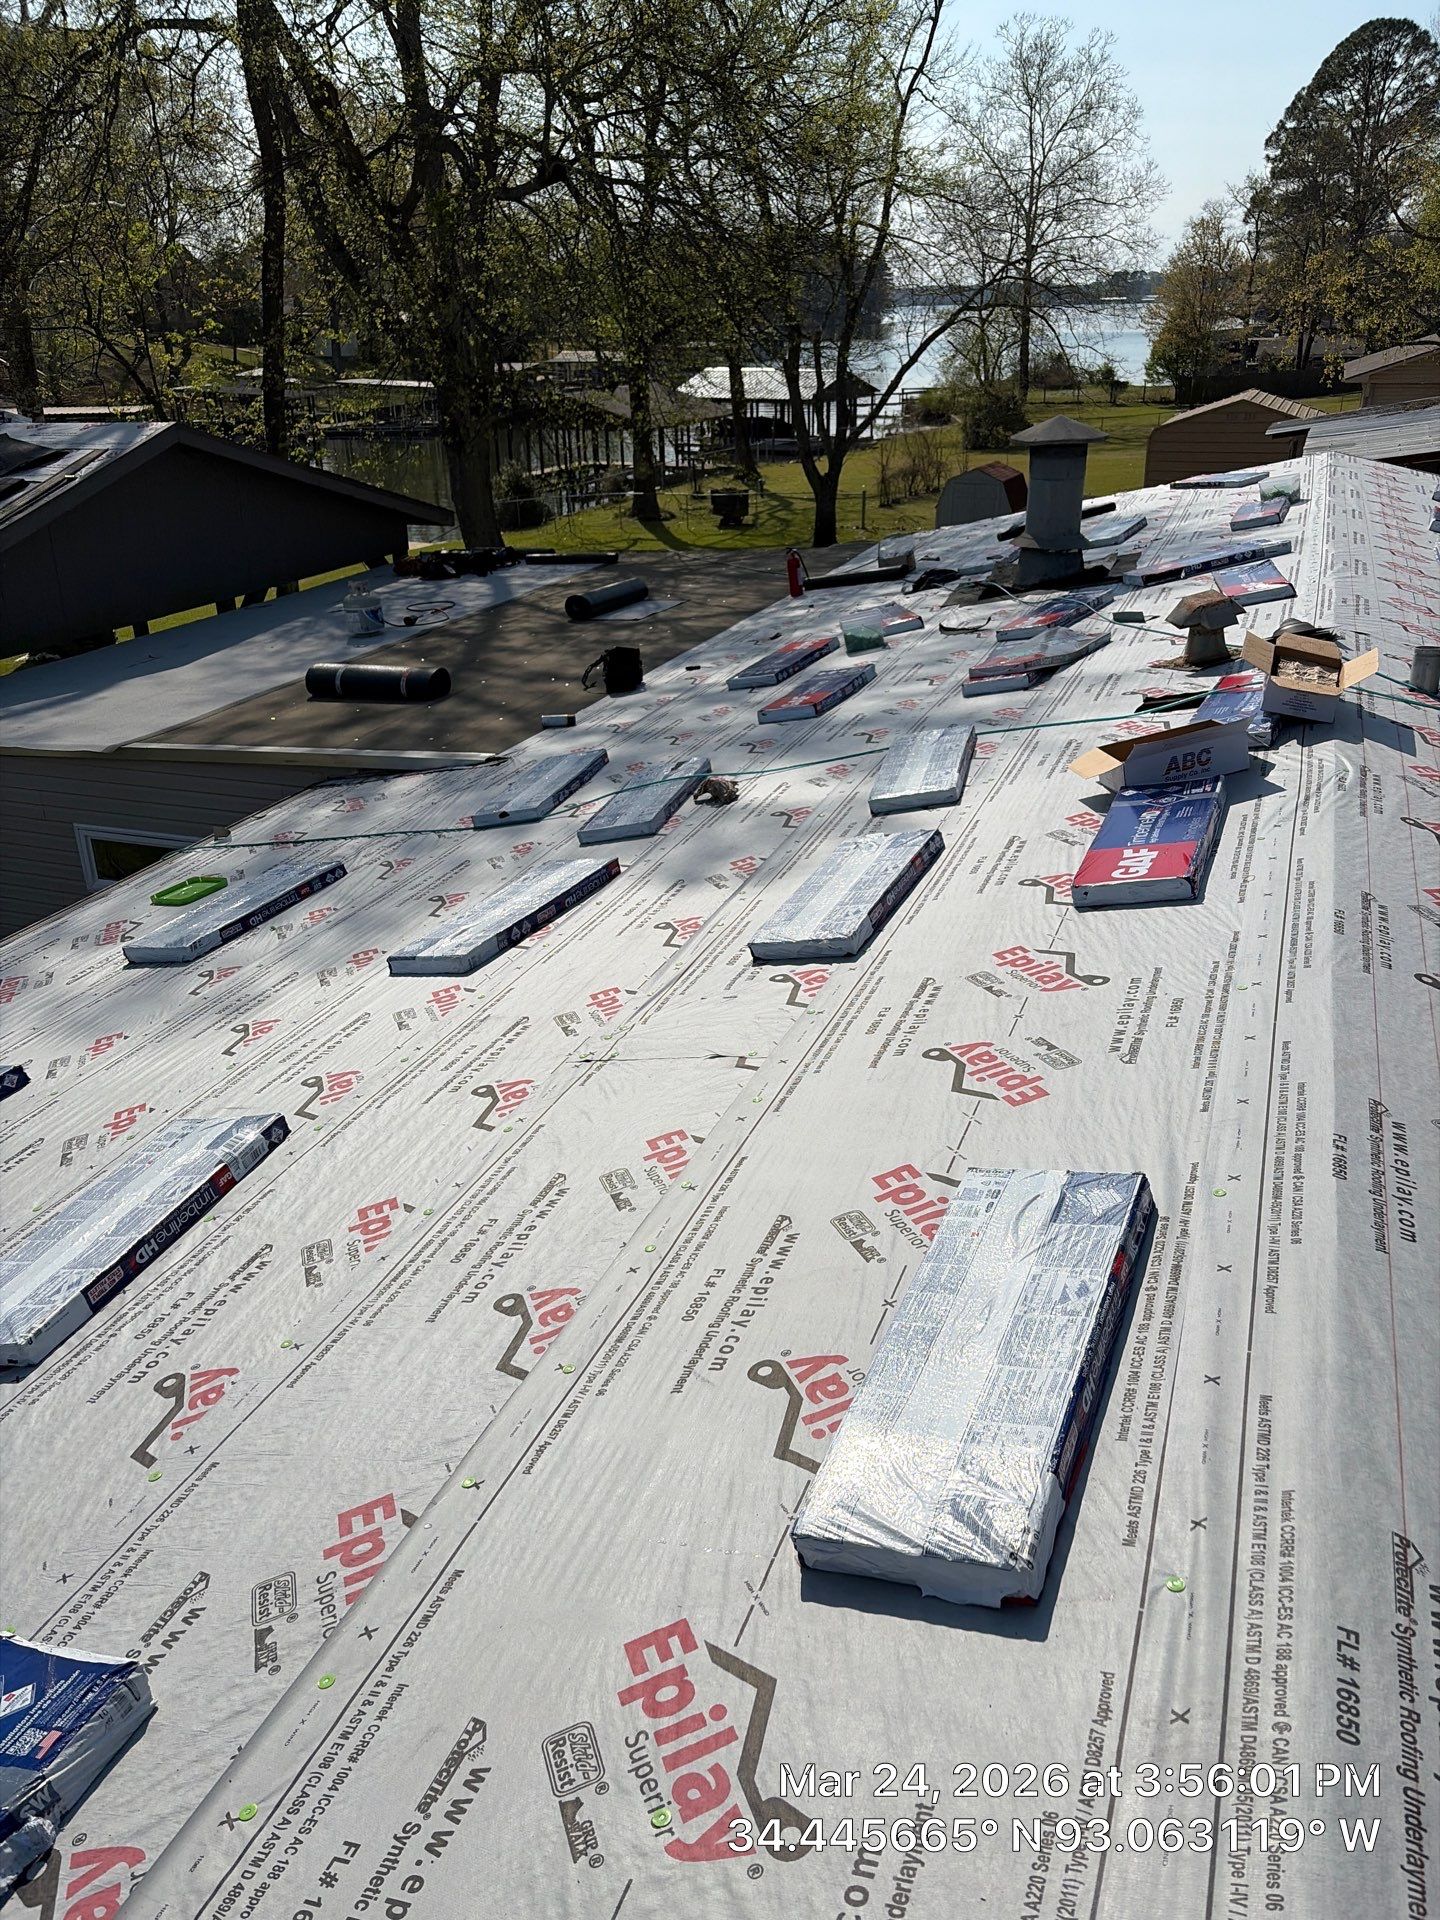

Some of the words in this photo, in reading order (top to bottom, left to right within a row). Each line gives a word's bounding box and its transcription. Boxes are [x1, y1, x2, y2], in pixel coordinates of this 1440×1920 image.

[1162, 748, 1214, 776] ABC
[1164, 771, 1188, 783] Supply
[1111, 848, 1159, 878] GAF
[1006, 969, 1042, 993] Superior
[892, 984, 943, 1057] www.epilay.com
[1108, 977, 1142, 1054] www.epilay.com
[1168, 998, 1184, 1015] 16850
[994, 1047, 1037, 1074] Superior
[1367, 1134, 1385, 1167] Synthetic
[216, 1171, 234, 1187] GAF
[1332, 1155, 1347, 1180] 16850
[1369, 1166, 1386, 1196] Roofing
[1390, 1121, 1417, 1243] www.epilay.com
[151, 1188, 221, 1243] Timberline
[500, 1208, 533, 1240] Synthetic
[835, 1217, 857, 1238] Resist
[884, 1209, 930, 1251] Superior
[1371, 1196, 1390, 1254] Underlayment
[135, 1241, 160, 1264] HD
[450, 1236, 481, 1265] 16850
[461, 1187, 570, 1305] www.epilay.com
[471, 1239, 504, 1275] Roofing
[704, 1268, 726, 1288] FL#
[736, 1257, 764, 1295] Synthetic
[424, 1267, 475, 1324] Underlayment
[682, 1290, 711, 1322] 16850
[708, 1232, 800, 1372] www.epilay.com
[1142, 1293, 1156, 1321] approved
[127, 1258, 273, 1386] www.epilay.com
[134, 1312, 171, 1340] 16850
[714, 1294, 742, 1332] Roofing
[1137, 1323, 1150, 1333] 188
[1157, 1324, 1171, 1345] ASTM
[670, 1329, 715, 1394] Underlayment
[1130, 1347, 1145, 1369] ICC-ES
[1150, 1353, 1166, 1381] (CLASS
[86, 1344, 153, 1405] Underlayment
[1127, 1371, 1141, 1386] 1004
[1121, 1388, 1138, 1413] CCRR#
[1147, 1383, 1162, 1399] E108
[1259, 1394, 1272, 1416] Meets
[1143, 1401, 1158, 1423] ASTM
[1115, 1414, 1132, 1441] Intertek
[1257, 1417, 1271, 1445] ASTMD
[522, 1441, 552, 1474] Approved
[1135, 1450, 1152, 1467] Type
[1256, 1447, 1270, 1461] 226
[195, 1462, 219, 1481] Meets
[1132, 1470, 1147, 1484] 226
[1252, 1463, 1270, 1482] Type
[170, 1483, 199, 1508] ASTMD
[1127, 1486, 1144, 1518] ASTMD
[1281, 1490, 1296, 1523] Intertek
[155, 1510, 173, 1526] 226
[1252, 1514, 1267, 1541] ASTM
[137, 1525, 159, 1545] Type
[1122, 1520, 1139, 1547] Meets
[1280, 1525, 1295, 1558] CCRR#
[121, 1550, 151, 1578] Intertek
[1251, 1543, 1266, 1566] E108
[89, 1569, 115, 1592] ASTM
[439, 1570, 464, 1594] Meets
[1279, 1560, 1294, 1583] 1004
[93, 1577, 124, 1609] CCRR#
[258, 1583, 274, 1620] Resist
[1247, 1569, 1265, 1606] (CLASS
[1278, 1585, 1293, 1620] ICC-ES
[69, 1594, 91, 1614] E108
[416, 1596, 445, 1629] ASTMD
[73, 1611, 95, 1630] 1004
[403, 1631, 421, 1647] 226
[1246, 1622, 1262, 1654] ASTM
[1276, 1642, 1291, 1660] 188
[1337, 1626, 1360, 1673] FL#
[385, 1651, 409, 1672] Type
[1393, 1622, 1419, 1703] Synthetic
[374, 1684, 409, 1721] Intertek
[1092, 1671, 1115, 1728] Approved
[1241, 1668, 1260, 1731] 4869/ASTM
[1271, 1664, 1288, 1717] approved
[338, 1709, 367, 1740] ASTM
[1336, 1677, 1361, 1747] 16850
[318, 1743, 344, 1769] E108
[347, 1725, 380, 1763] CCRR#
[1084, 1728, 1105, 1767] D8257
[1399, 1705, 1423, 1783] Roofing
[549, 1736, 577, 1790] Resist
[286, 1772, 324, 1815] (CLASS
[327, 1766, 352, 1791] 1004
[298, 1794, 334, 1834] ICC-ES
[249, 1832, 281, 1868] ASTM
[581, 1819, 599, 1851] GRIP
[267, 1860, 289, 1880] 188
[320, 1840, 361, 1889] FL#
[354, 1821, 422, 1912] Synthetic
[1026, 1877, 1047, 1912] A220
[1057, 1879, 1085, 1920] (2011)
[1230, 1883, 1247, 1908] I-IV
